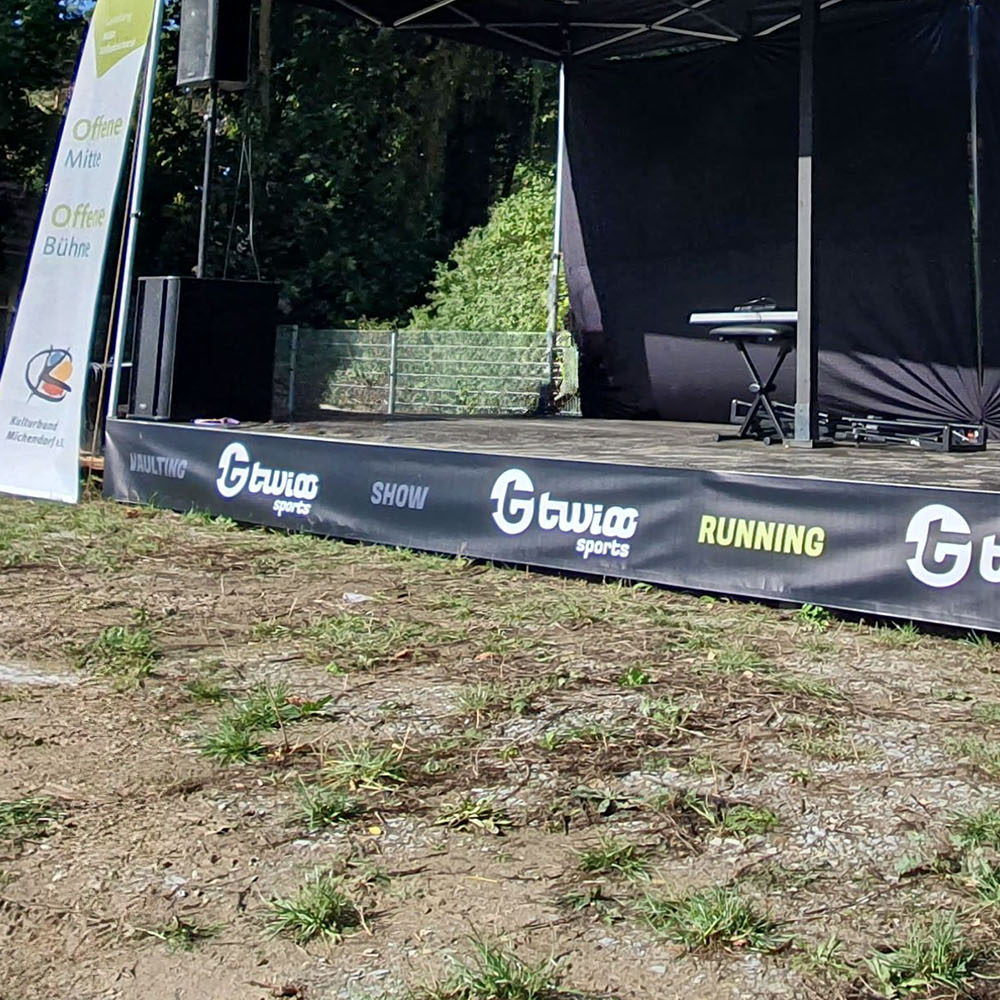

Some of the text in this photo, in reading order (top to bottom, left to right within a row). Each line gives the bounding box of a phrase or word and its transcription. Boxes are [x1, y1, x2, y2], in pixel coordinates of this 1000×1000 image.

[72, 115, 123, 141] Offene
[64, 149, 102, 169] Mitte
[51, 203, 105, 229] Offene
[43, 236, 91, 258] Bühne
[129, 453, 188, 480] VAULTING
[272, 499, 312, 518] sports
[370, 481, 430, 510] SHOW
[575, 538, 630, 560] sports
[697, 514, 826, 558] RUNNING
